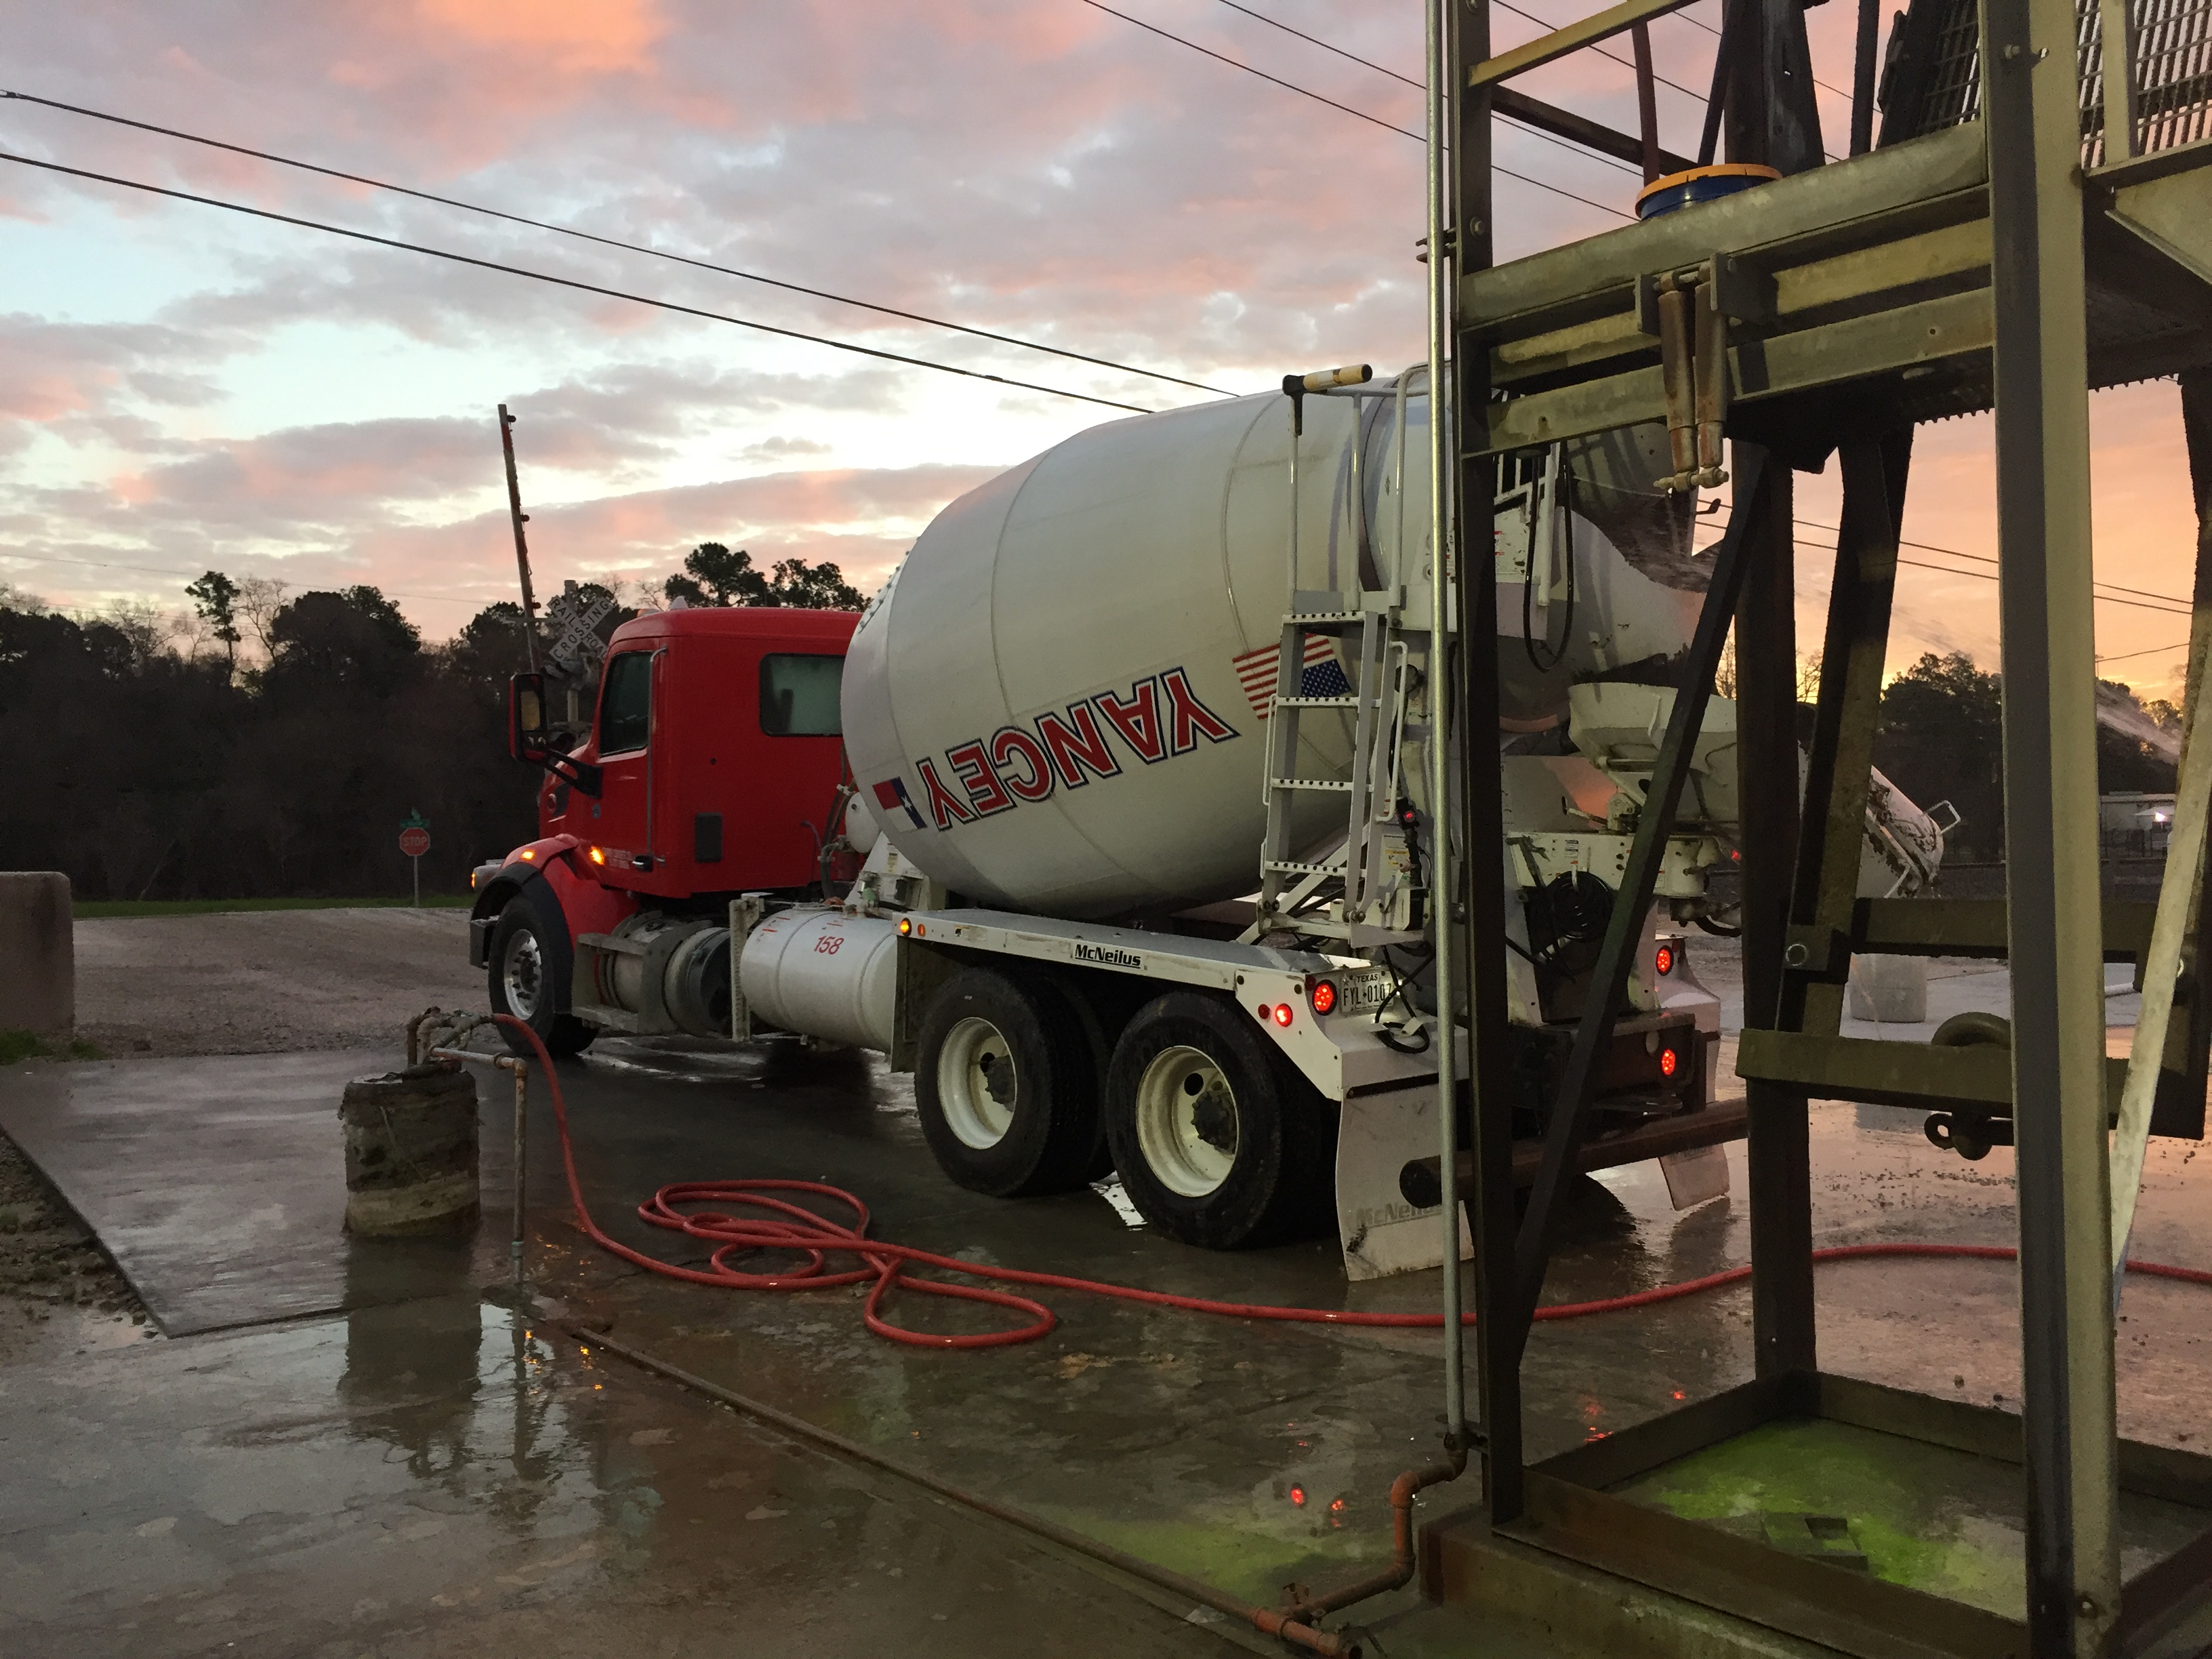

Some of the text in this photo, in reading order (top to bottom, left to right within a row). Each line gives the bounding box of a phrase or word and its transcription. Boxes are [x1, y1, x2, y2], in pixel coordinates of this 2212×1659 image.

[549, 598, 575, 628] RAIL
[553, 600, 609, 659] CROSSING
[916, 665, 1242, 832] YANCEY
[403, 836, 428, 846] STOP
[813, 935, 844, 955] 158
[1075, 944, 1141, 966] McNeilus
[1356, 974, 1378, 983] TEXAS
